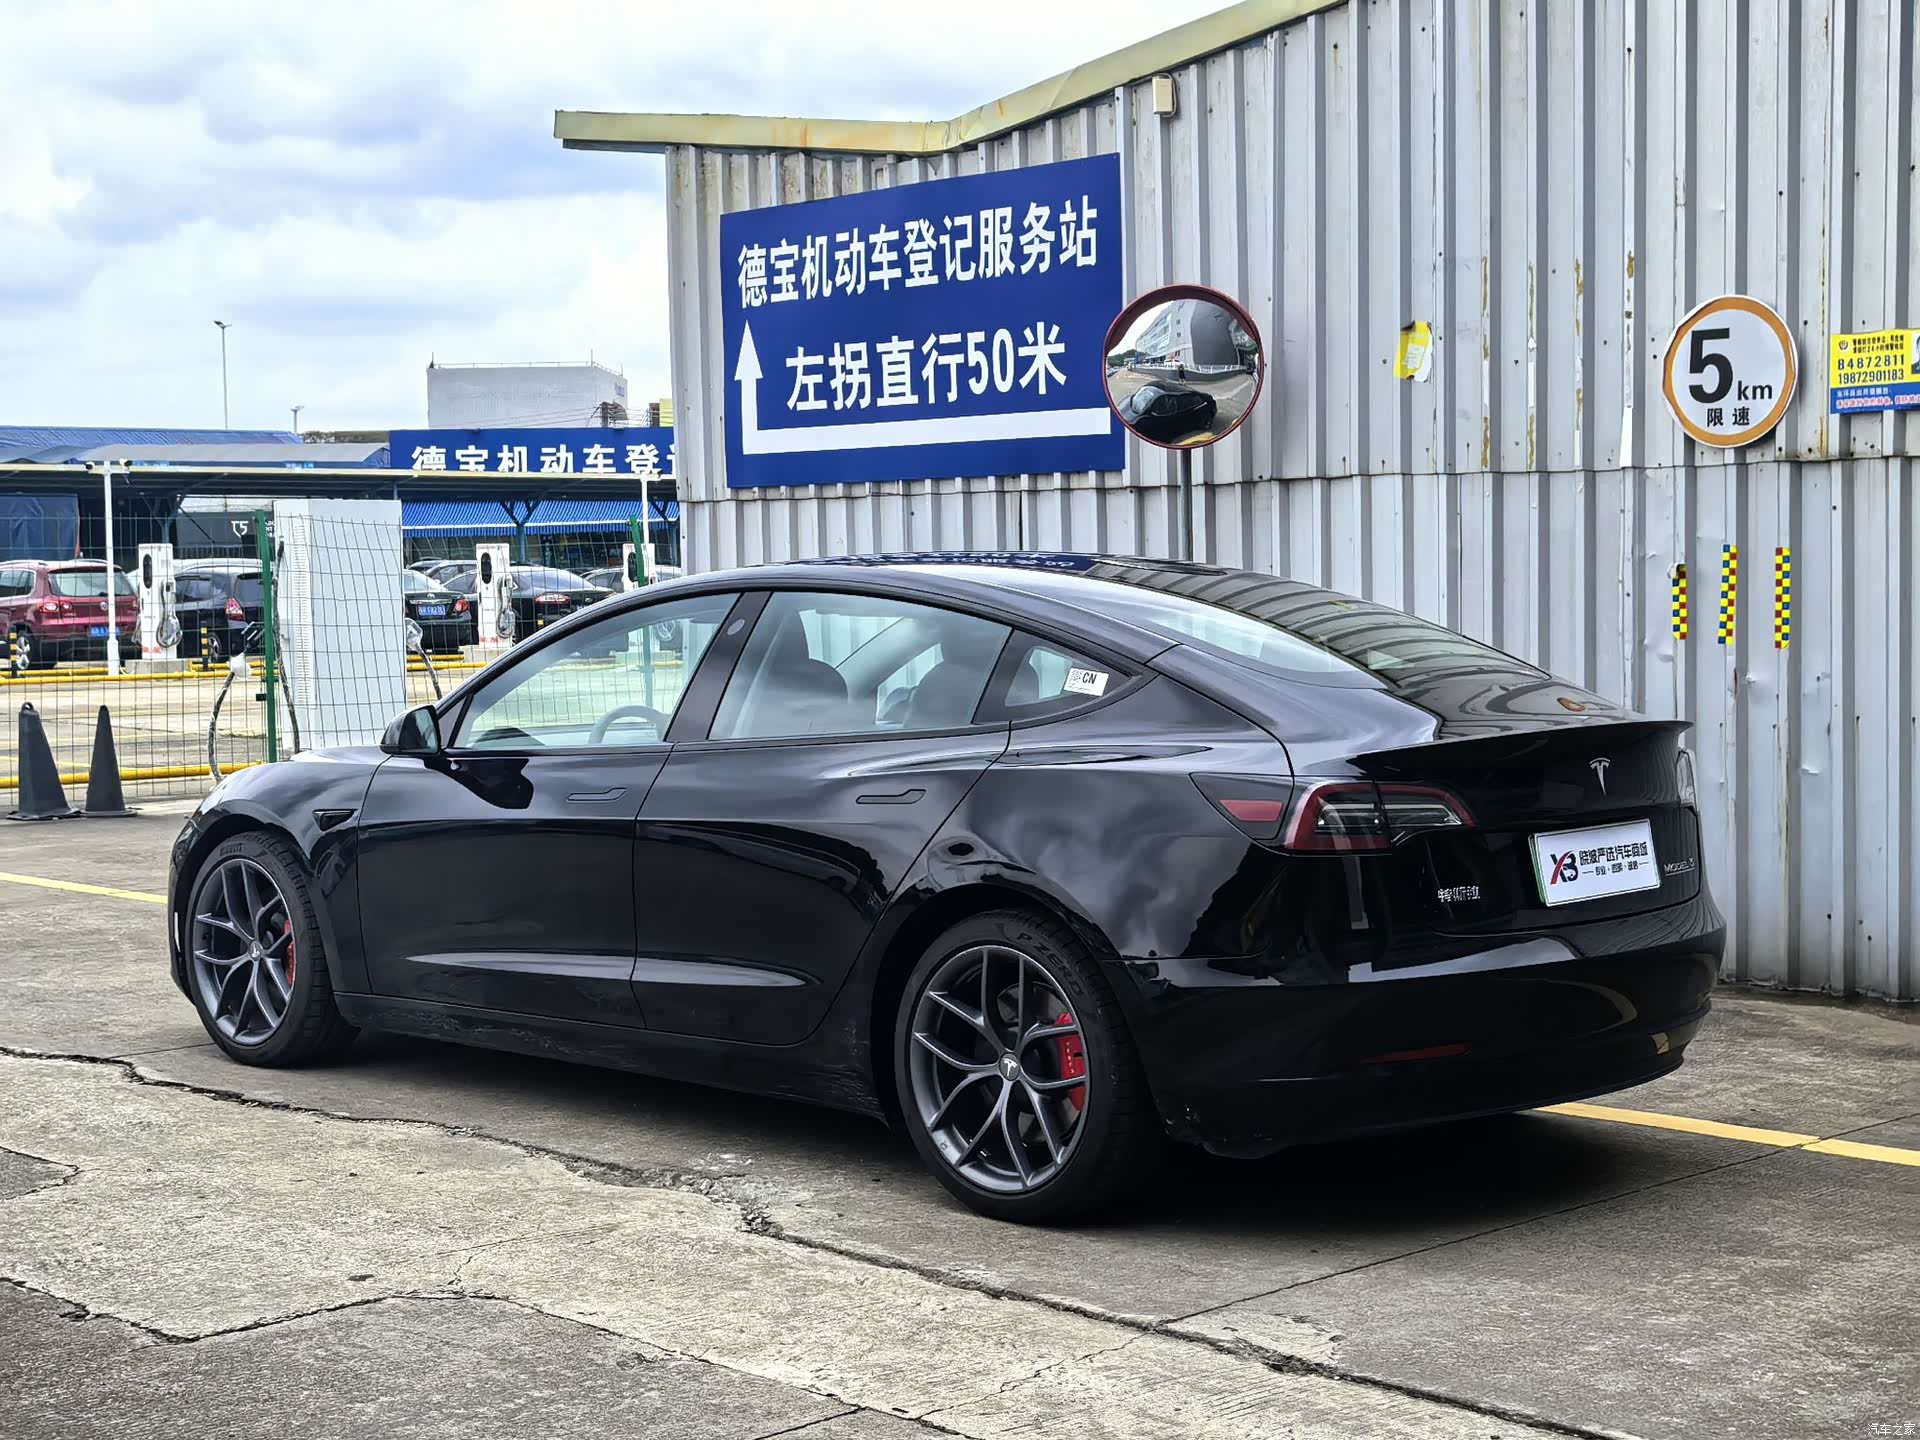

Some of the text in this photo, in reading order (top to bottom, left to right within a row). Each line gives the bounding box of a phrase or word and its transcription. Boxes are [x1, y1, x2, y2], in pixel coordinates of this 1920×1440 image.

[738, 195, 1098, 309] 德宝机动车登记服务站
[785, 321, 1067, 412] 左拐直行50米
[1688, 327, 1773, 404] 5 km
[1838, 369, 1904, 384] 19872901183
[1706, 407, 1750, 428] 限速
[411, 444, 675, 475] 德宝机动车登
[1082, 672, 1097, 685] CN
